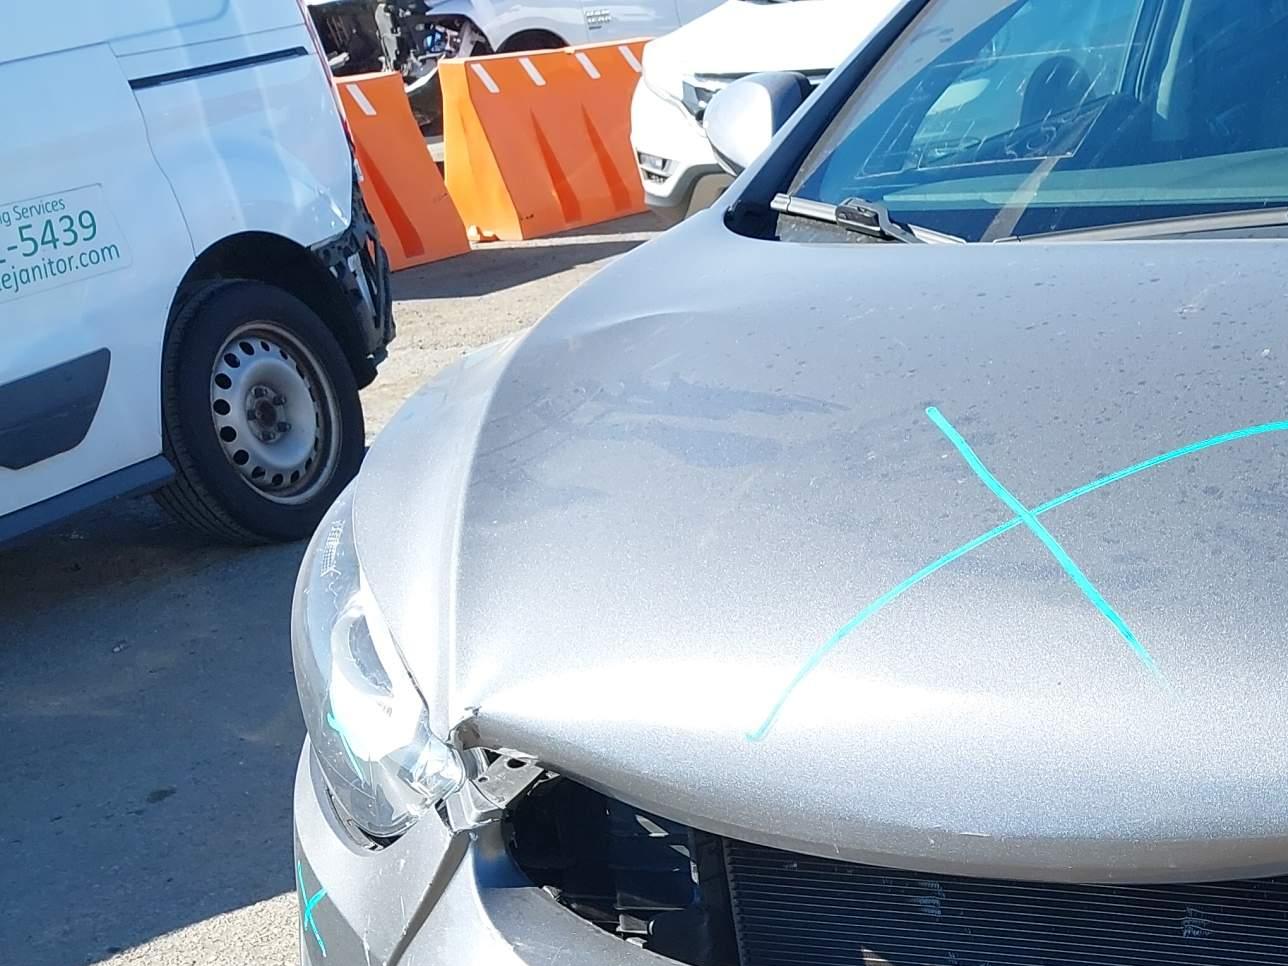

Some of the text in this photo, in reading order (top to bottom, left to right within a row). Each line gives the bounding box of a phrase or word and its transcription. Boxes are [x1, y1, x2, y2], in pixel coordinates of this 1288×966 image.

[13, 197, 66, 221] Services
[0, 210, 97, 264] -5439
[0, 244, 121, 293] ejanitor.com
